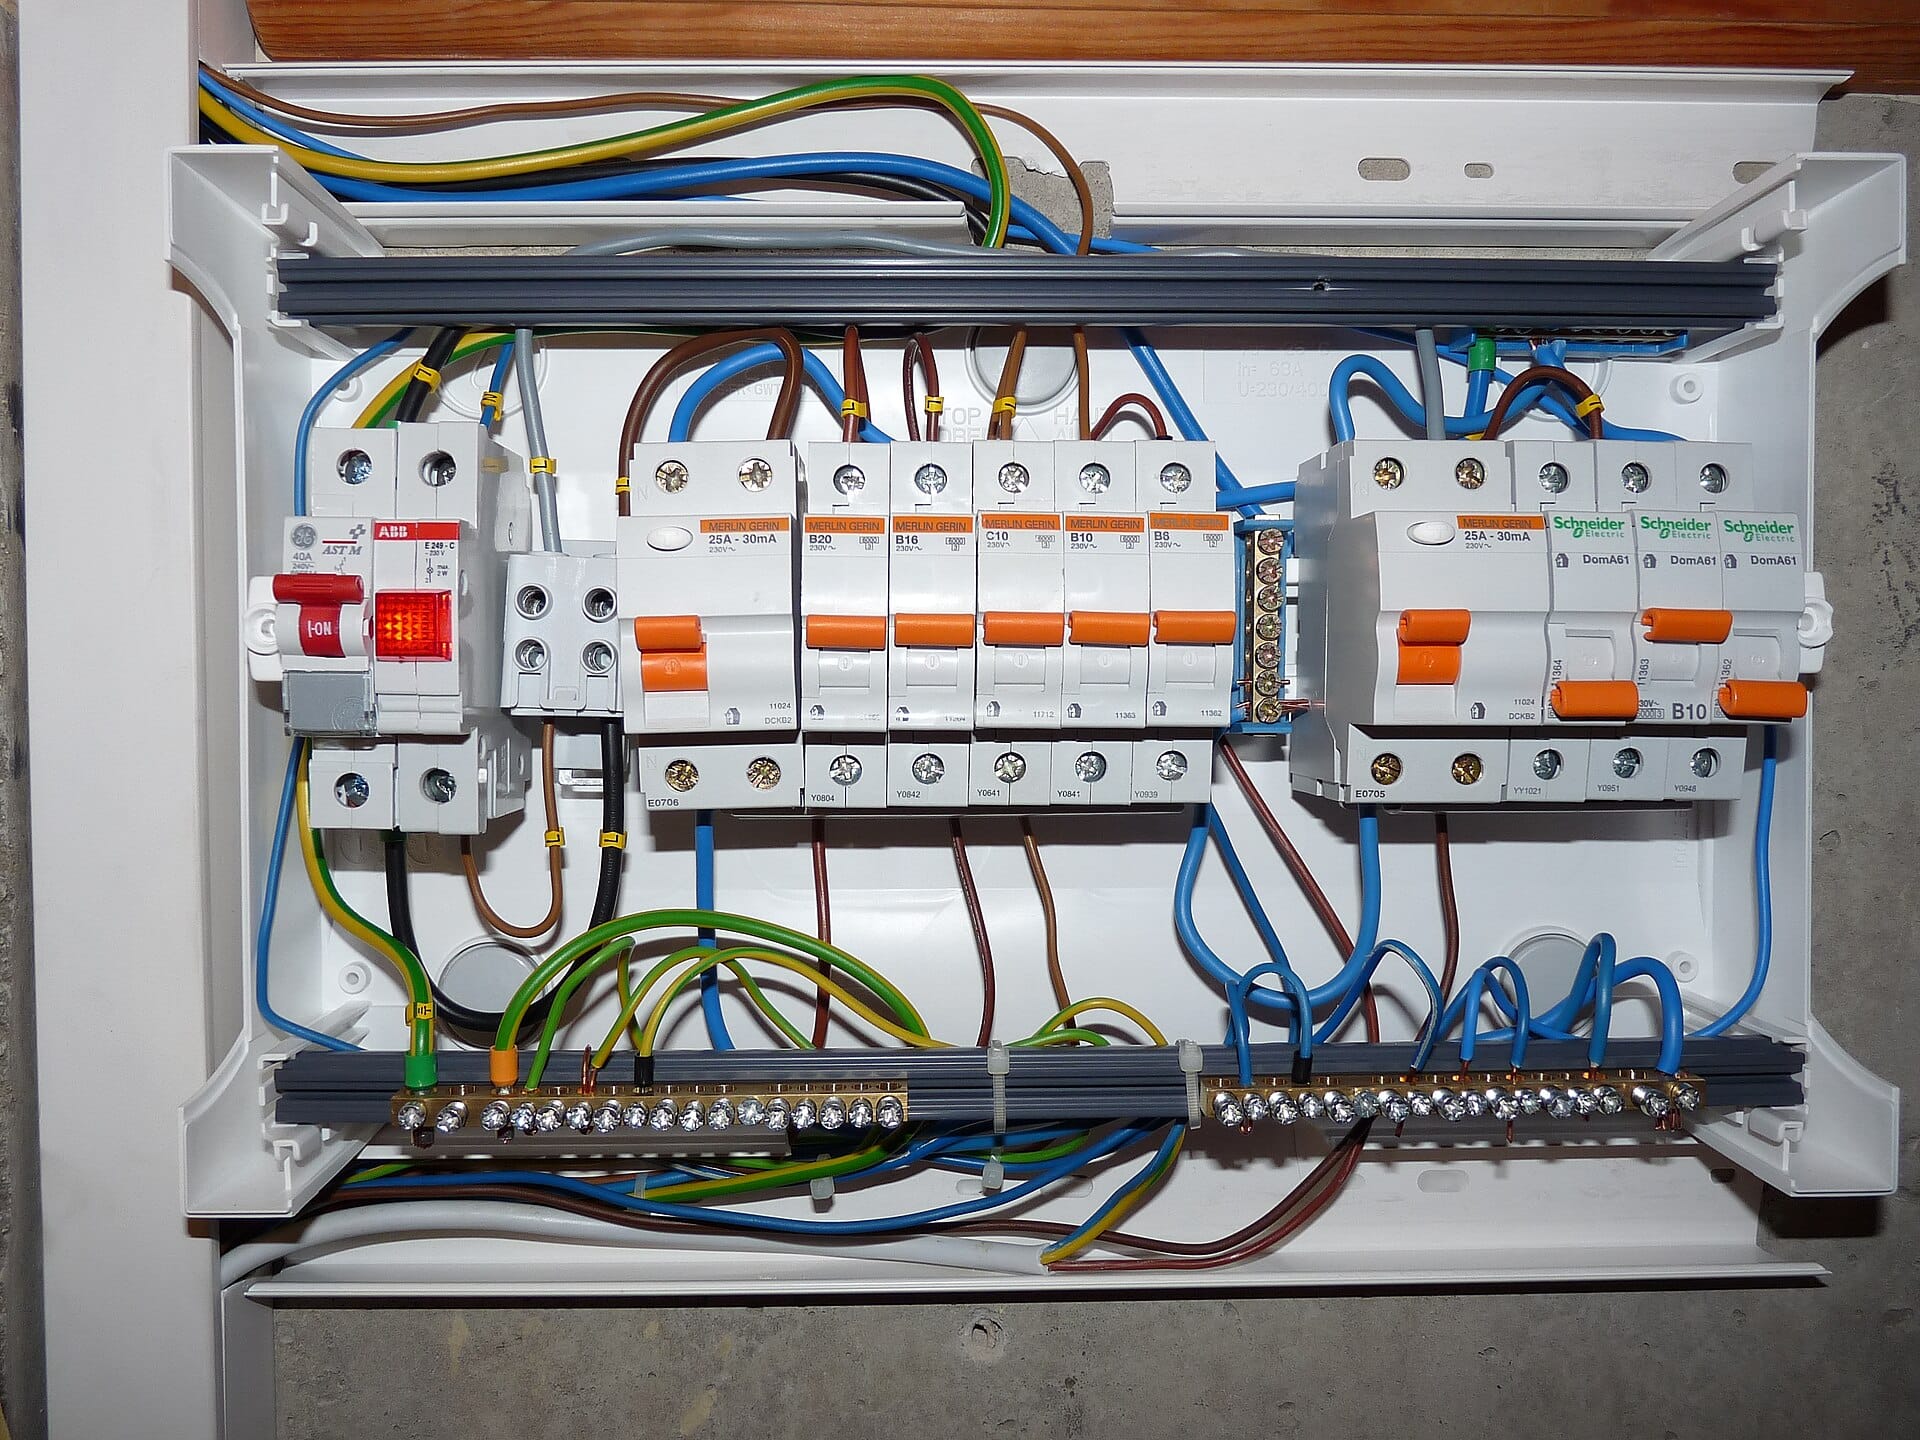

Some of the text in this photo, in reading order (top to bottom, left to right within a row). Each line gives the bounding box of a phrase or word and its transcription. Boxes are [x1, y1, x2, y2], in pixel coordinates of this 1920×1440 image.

[709, 521, 780, 532] MERLIN GERIN
[809, 521, 880, 531] MERLIN GERIN
[896, 521, 966, 531] MERLIN GERIN
[985, 519, 1055, 529] MERLIN GERIN
[1070, 519, 1140, 529] MERLIN GERIN
[1154, 518, 1223, 528] MERLIN GERIN
[1463, 518, 1531, 529] MERLIN GERIN
[1553, 516, 1625, 530] Schneider
[1640, 516, 1711, 531] Schneider
[1723, 519, 1794, 534] Schneider
[378, 525, 408, 538] ABB
[986, 531, 1009, 541] C10
[1464, 531, 1487, 541] 25A
[1497, 531, 1531, 541] 30mA
[1585, 529, 1625, 538] Electric
[1671, 530, 1711, 539] Electric
[708, 534, 732, 545] 25A
[742, 533, 777, 544] 30mA
[809, 534, 832, 544] B20
[896, 535, 918, 545] B16
[1070, 532, 1093, 542] B10
[1756, 534, 1795, 543] Electric
[292, 552, 313, 561] 40A
[1583, 554, 1630, 565] DomA61
[1670, 555, 1717, 565] DomA61
[1750, 555, 1797, 566] DomA61
[1637, 658, 1650, 685] 11363
[1513, 698, 1535, 706] 11024
[1508, 712, 1535, 720] DCKB2
[1672, 703, 1706, 719] B10
[764, 716, 792, 724] DCKB2
[897, 790, 921, 798] Y0842
[977, 789, 1000, 797] Y0641
[1355, 790, 1386, 798] E0705
[1513, 786, 1542, 795] YY1021
[811, 794, 835, 802] Y0804
